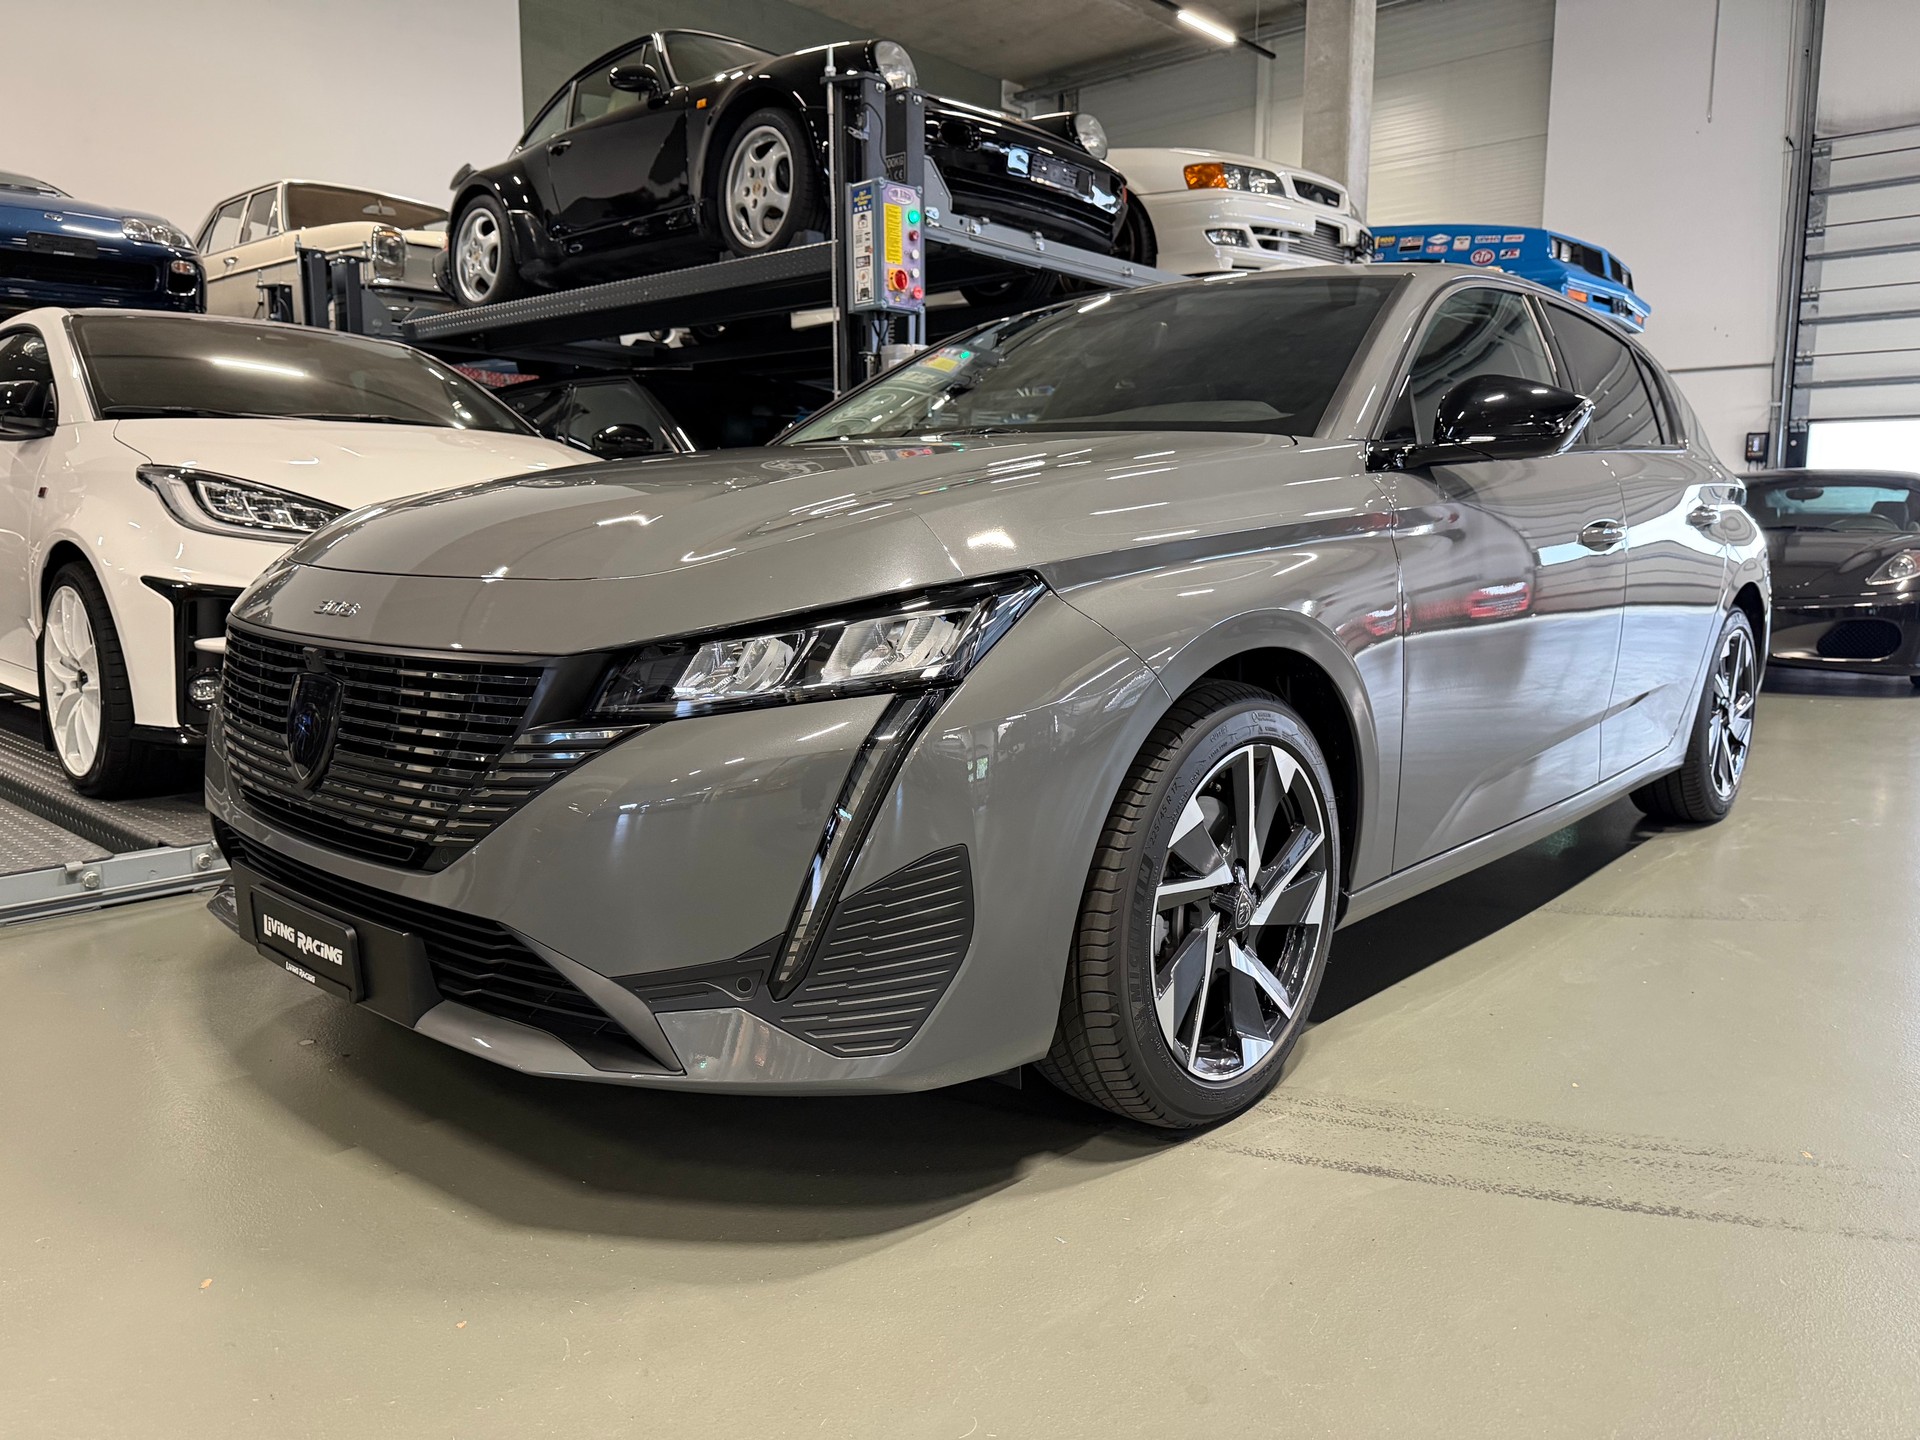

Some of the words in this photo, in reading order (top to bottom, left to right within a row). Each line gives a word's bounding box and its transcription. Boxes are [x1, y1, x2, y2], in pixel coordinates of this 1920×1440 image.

[1474, 249, 1493, 263] STP
[1150, 805, 1167, 846] 225/45
[1128, 854, 1152, 1003] MICHELIN
